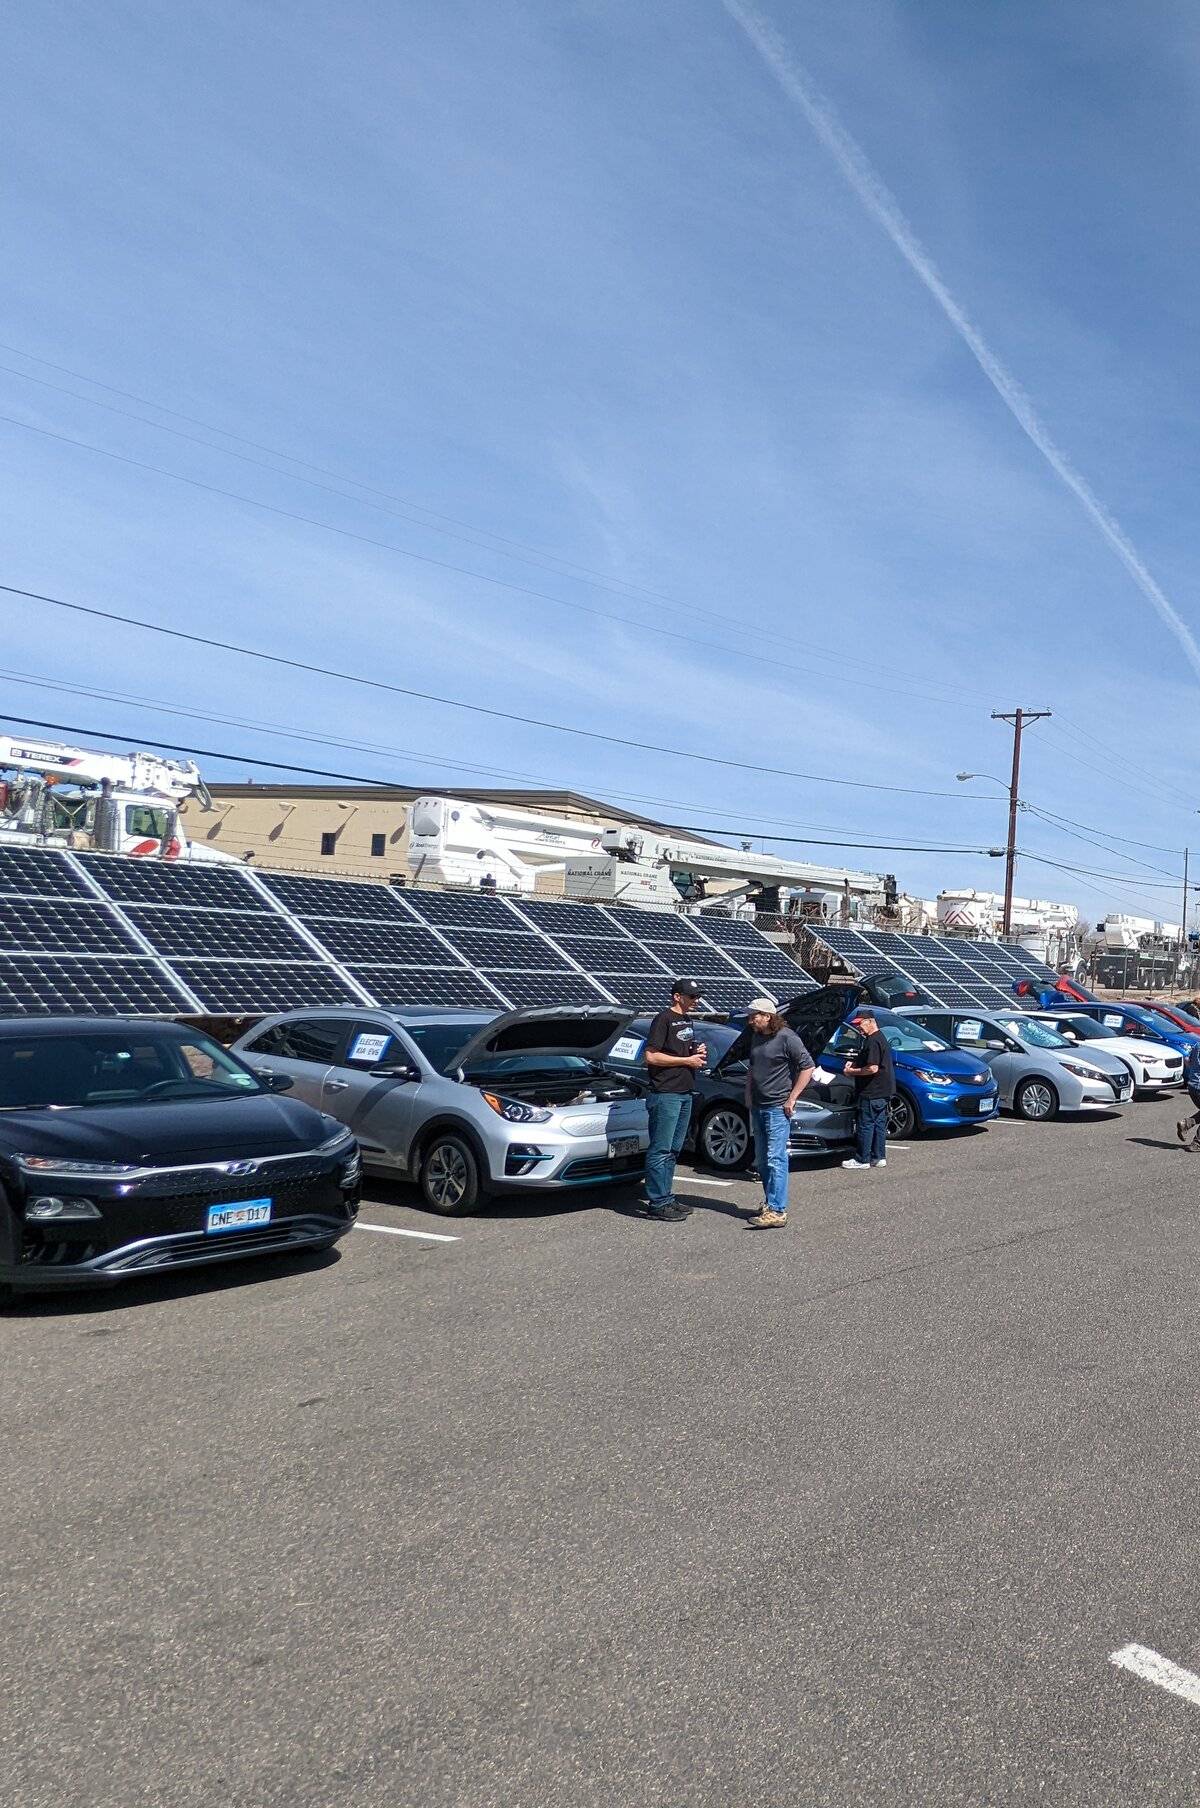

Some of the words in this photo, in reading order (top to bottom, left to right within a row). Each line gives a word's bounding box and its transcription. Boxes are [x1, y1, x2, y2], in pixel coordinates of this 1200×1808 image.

[25, 751, 64, 764] TEREX
[620, 870, 642, 878] NATIONAL
[359, 1037, 385, 1047] ELECTRIC
[356, 1047, 366, 1055] KIA
[211, 1211, 234, 1227] CNE
